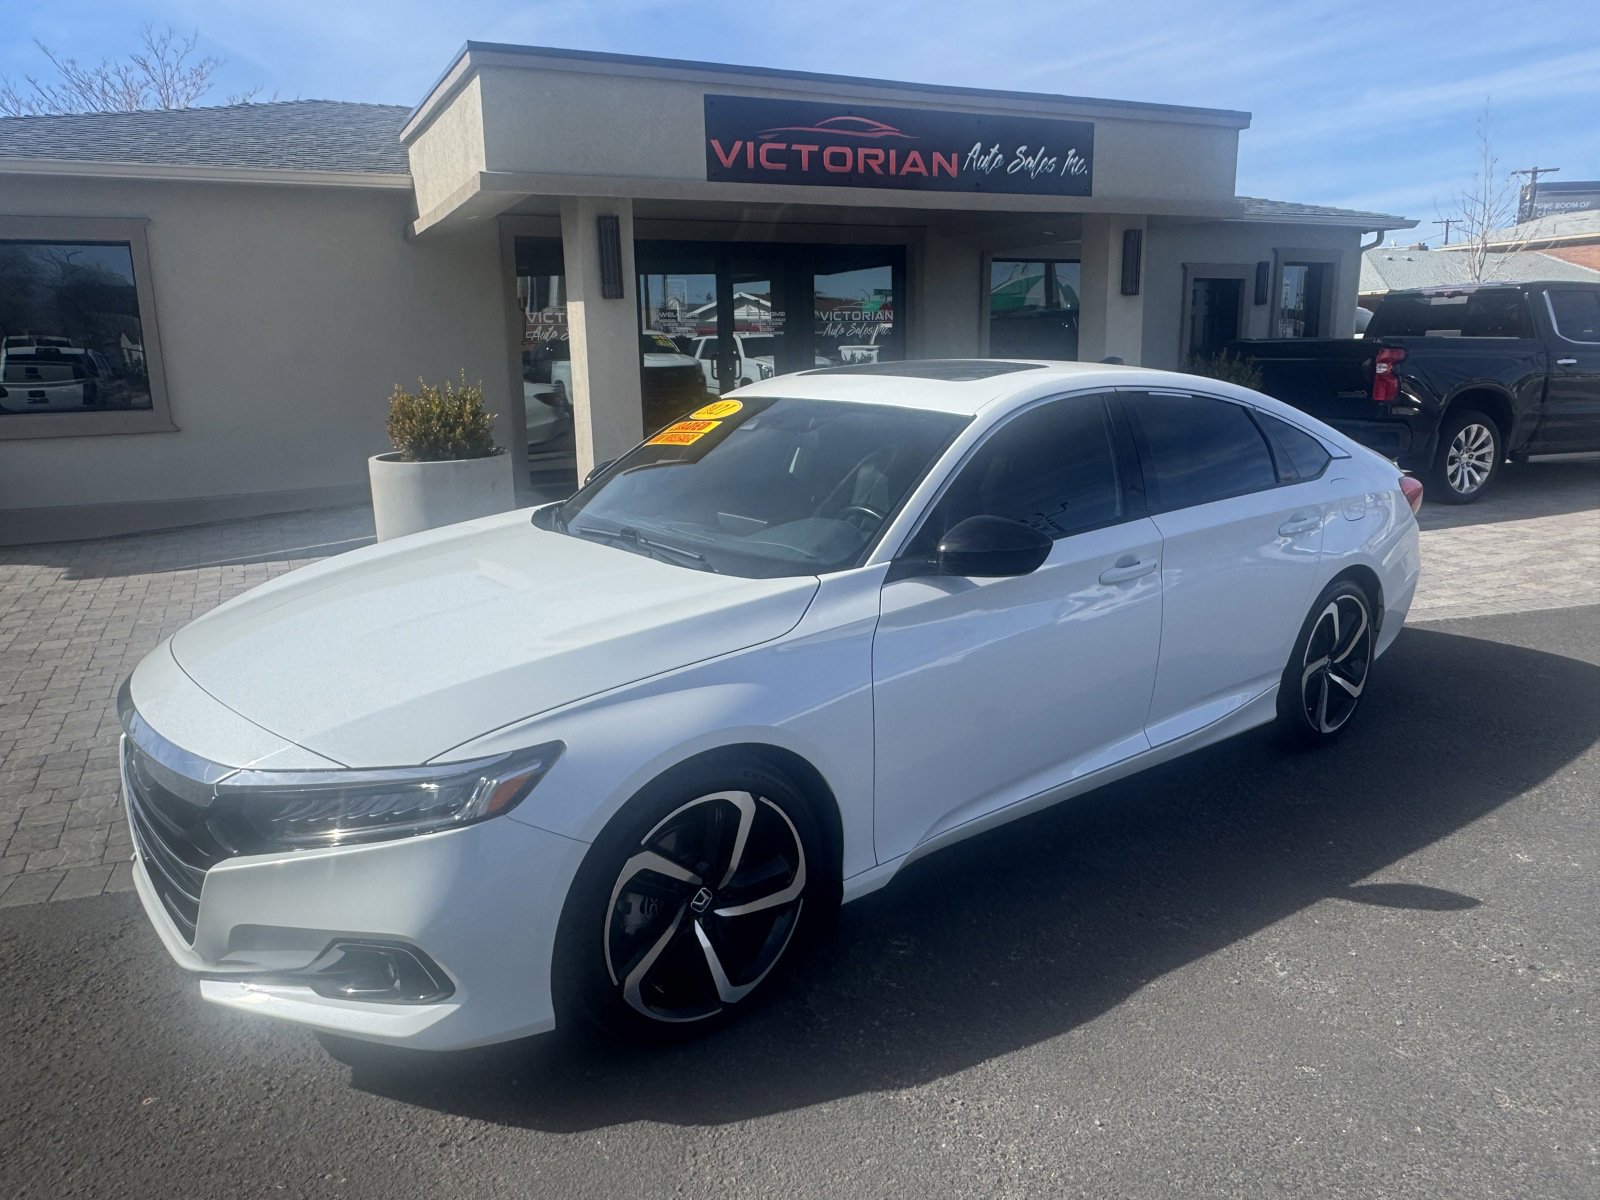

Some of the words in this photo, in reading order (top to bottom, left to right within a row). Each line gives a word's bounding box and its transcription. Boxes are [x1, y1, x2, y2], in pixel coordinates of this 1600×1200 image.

[710, 139, 959, 179] VICTORIAN
[963, 143, 1004, 176] Auto
[1006, 145, 1057, 180] Sales
[1060, 148, 1089, 176] Inc.
[820, 311, 893, 321] VICTORIAN
[823, 323, 844, 338] Auto
[846, 323, 873, 338] Sales
